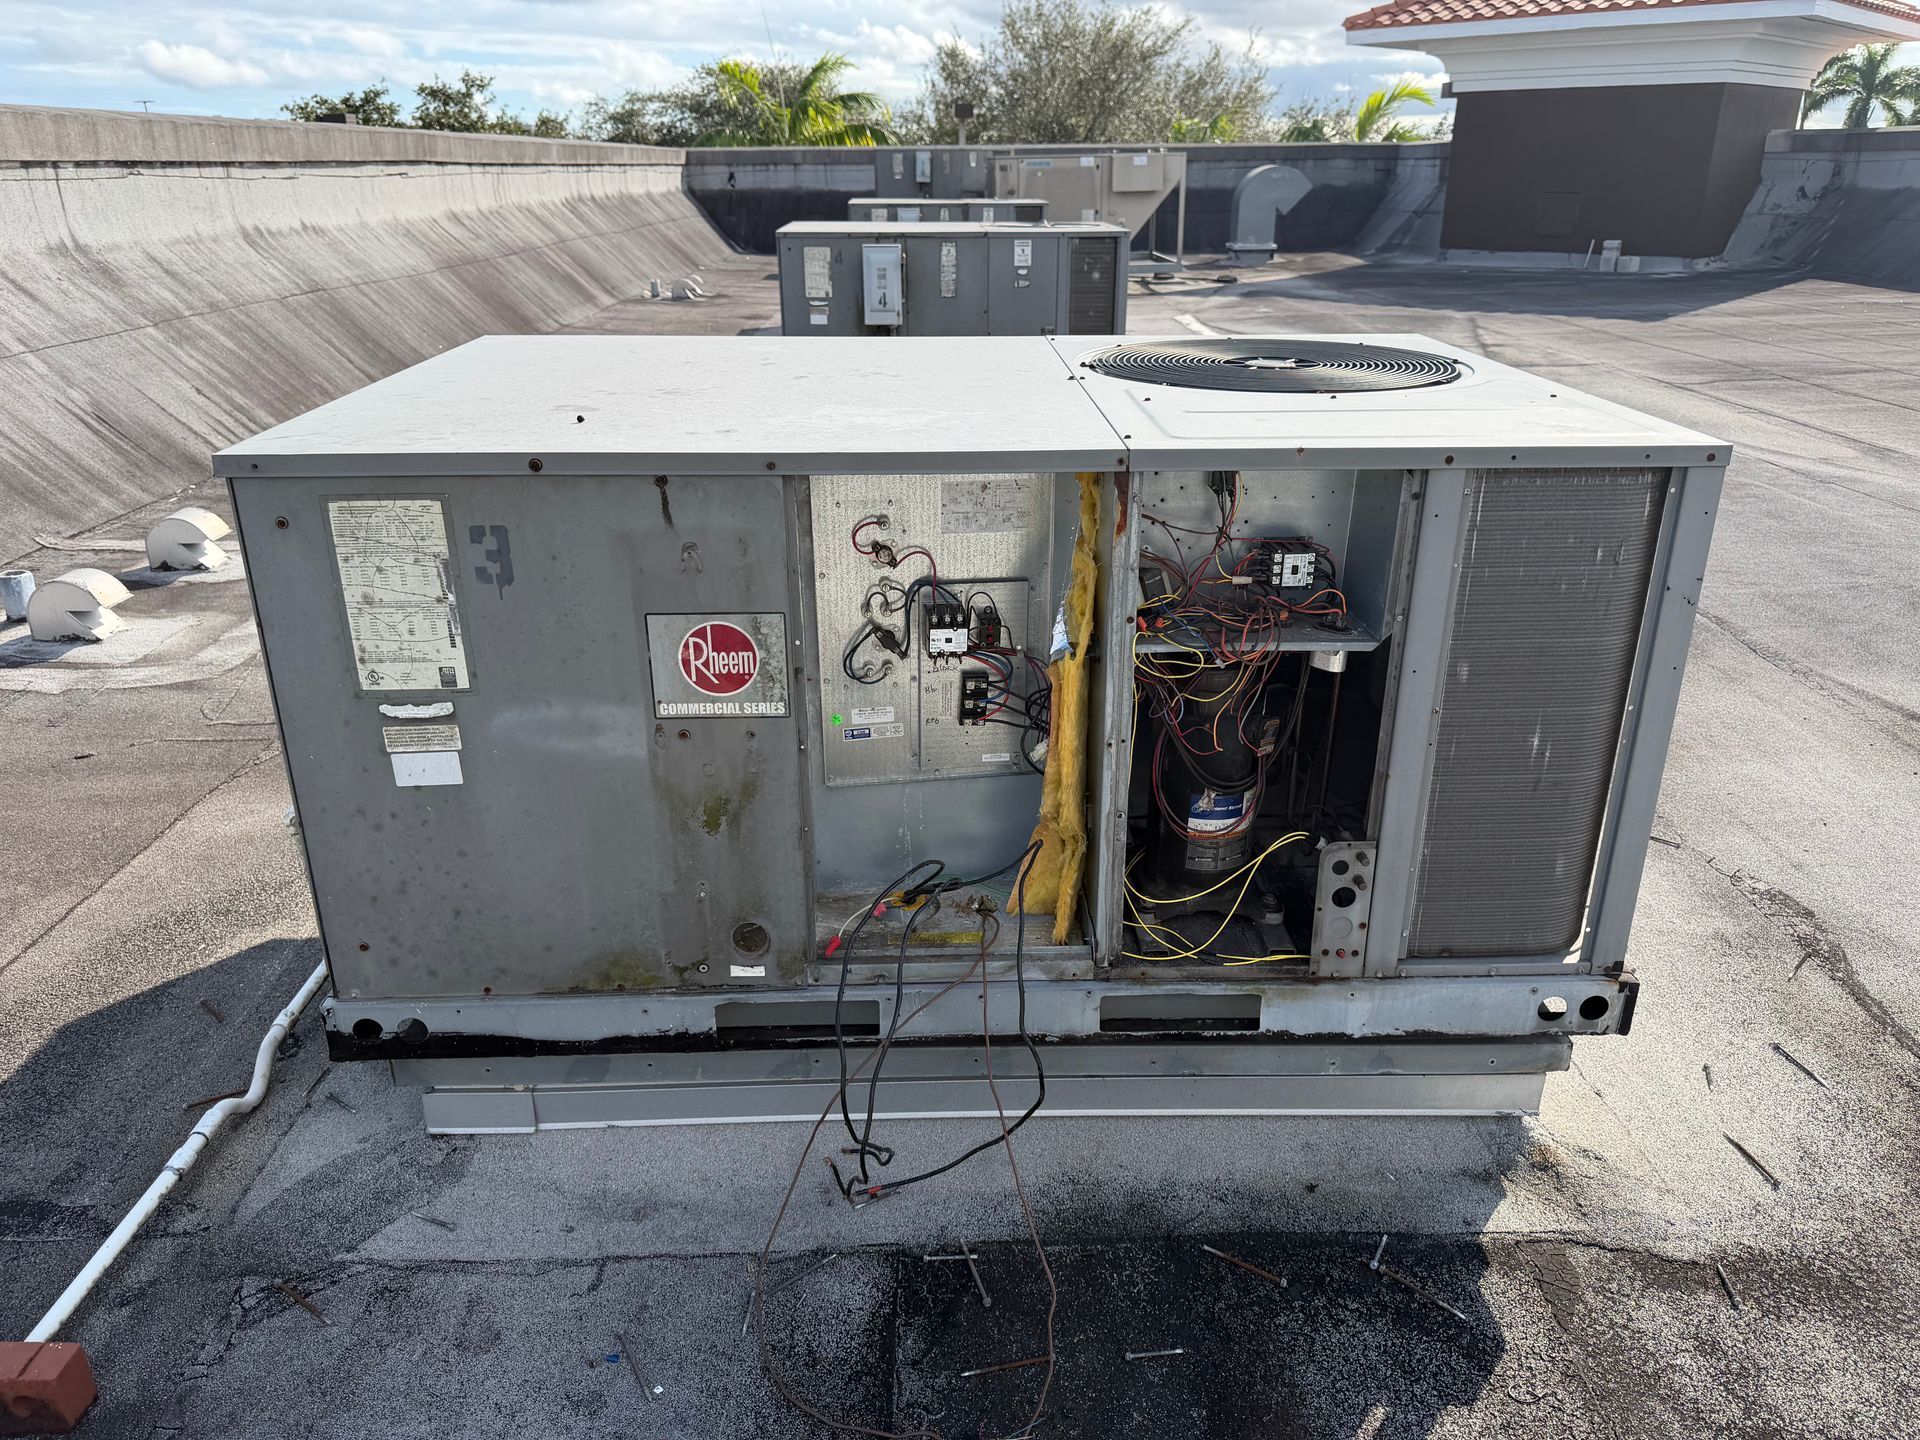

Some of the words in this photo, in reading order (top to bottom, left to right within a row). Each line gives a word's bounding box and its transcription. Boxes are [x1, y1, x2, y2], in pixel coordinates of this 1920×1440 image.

[878, 291, 888, 308] 4
[468, 525, 514, 590] 3
[688, 624, 755, 684] Rheem
[660, 702, 741, 715] COMMERCIAL
[743, 701, 786, 714] SERIES
